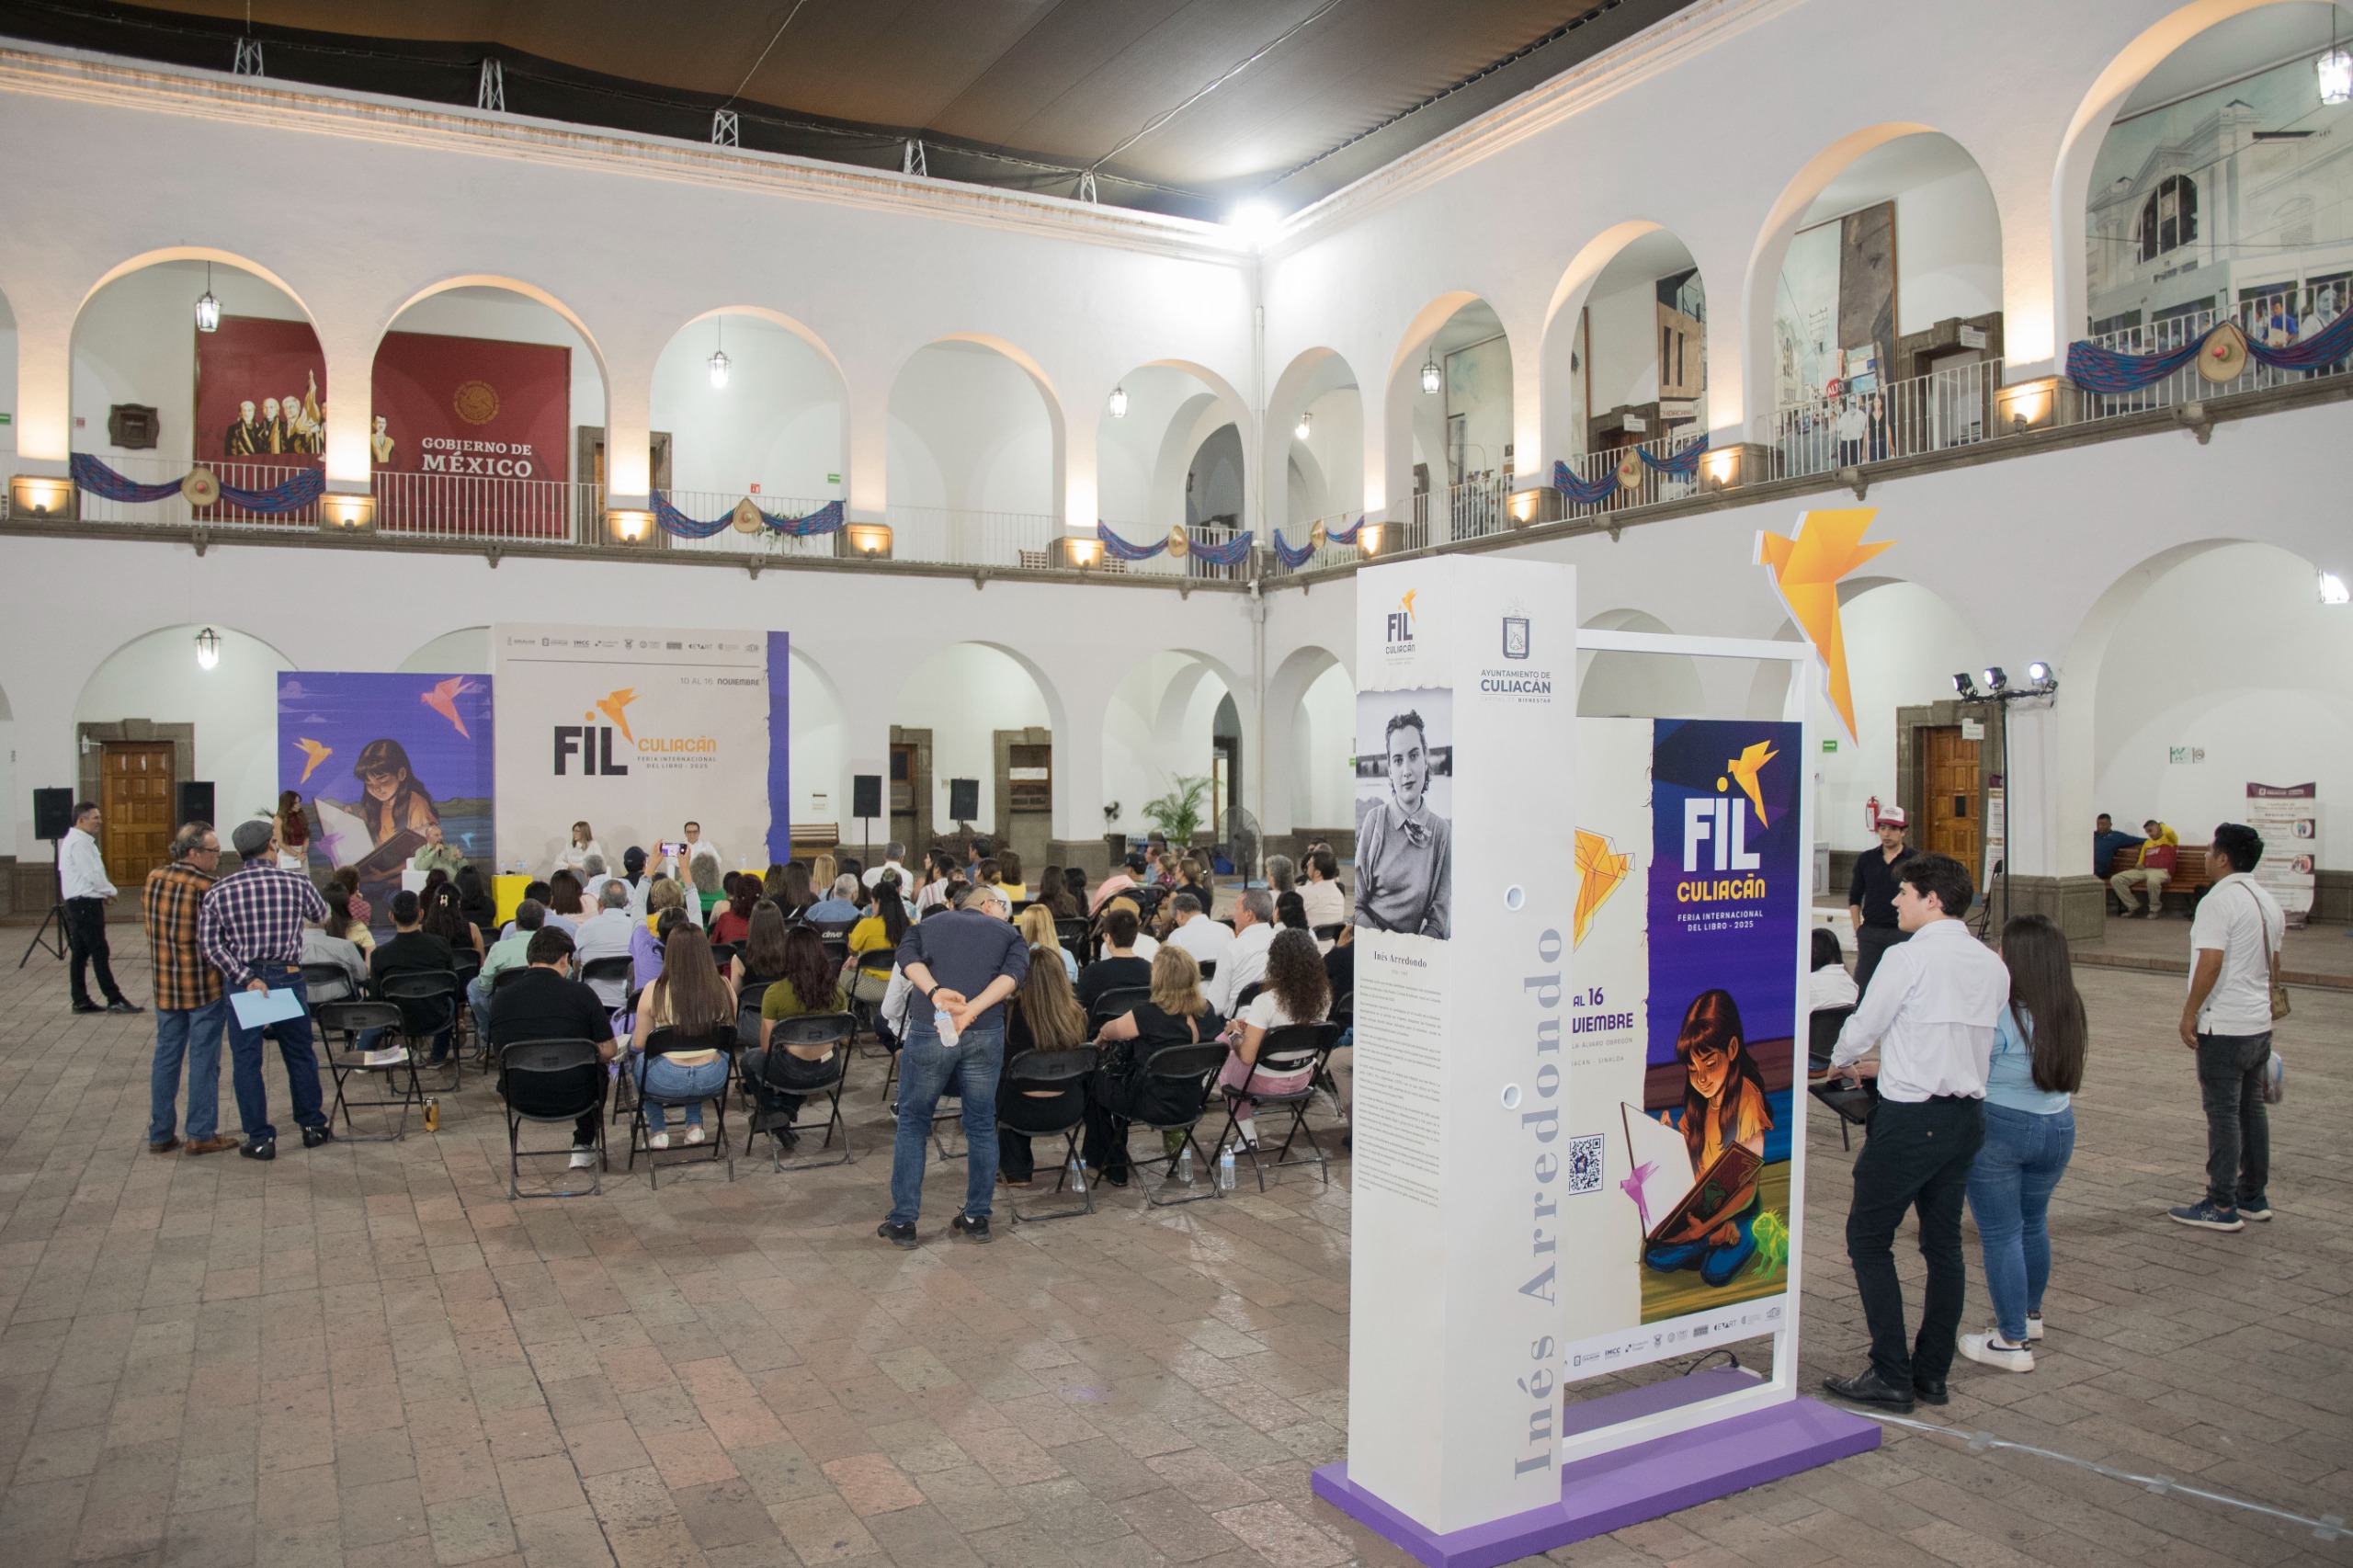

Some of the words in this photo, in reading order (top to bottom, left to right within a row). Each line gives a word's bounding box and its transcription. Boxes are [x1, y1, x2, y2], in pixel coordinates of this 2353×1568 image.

[422, 437, 506, 454] GOBIERNO
[511, 444, 532, 456] DE
[422, 451, 532, 477] MÉXICO
[1387, 612, 1413, 642] FIL
[1386, 642, 1415, 654] CULIACÁN
[717, 678, 760, 687] NOVIEMBRE
[1481, 669, 1539, 678] AYUNTAMIENTO
[1481, 678, 1551, 694] CULIACÁN
[554, 726, 628, 776] FIL
[638, 735, 717, 753] CULIACÁN
[1684, 798, 1760, 872] FIL
[1677, 873, 1766, 903] CULIACÁN
[1677, 914, 1700, 922] FERIA
[1702, 910, 1763, 920] INTERNACIONAL
[822, 930, 843, 938] drive
[1688, 924, 1701, 932] DEL
[1704, 922, 1728, 931] LIBRO
[1734, 920, 1754, 929] 2025
[1374, 950, 1388, 961] Inés
[1390, 954, 1427, 968] Arredondo
[1573, 995, 1586, 1007] AL
[1588, 987, 1604, 1006] 16
[1606, 1037, 1632, 1046] OBREGÓN
[1597, 1055, 1624, 1064] SINALOA
[1518, 928, 1562, 1307] Arredondo
[1605, 1346, 1620, 1356] IMCC
[1515, 1335, 1554, 1481] Inés
